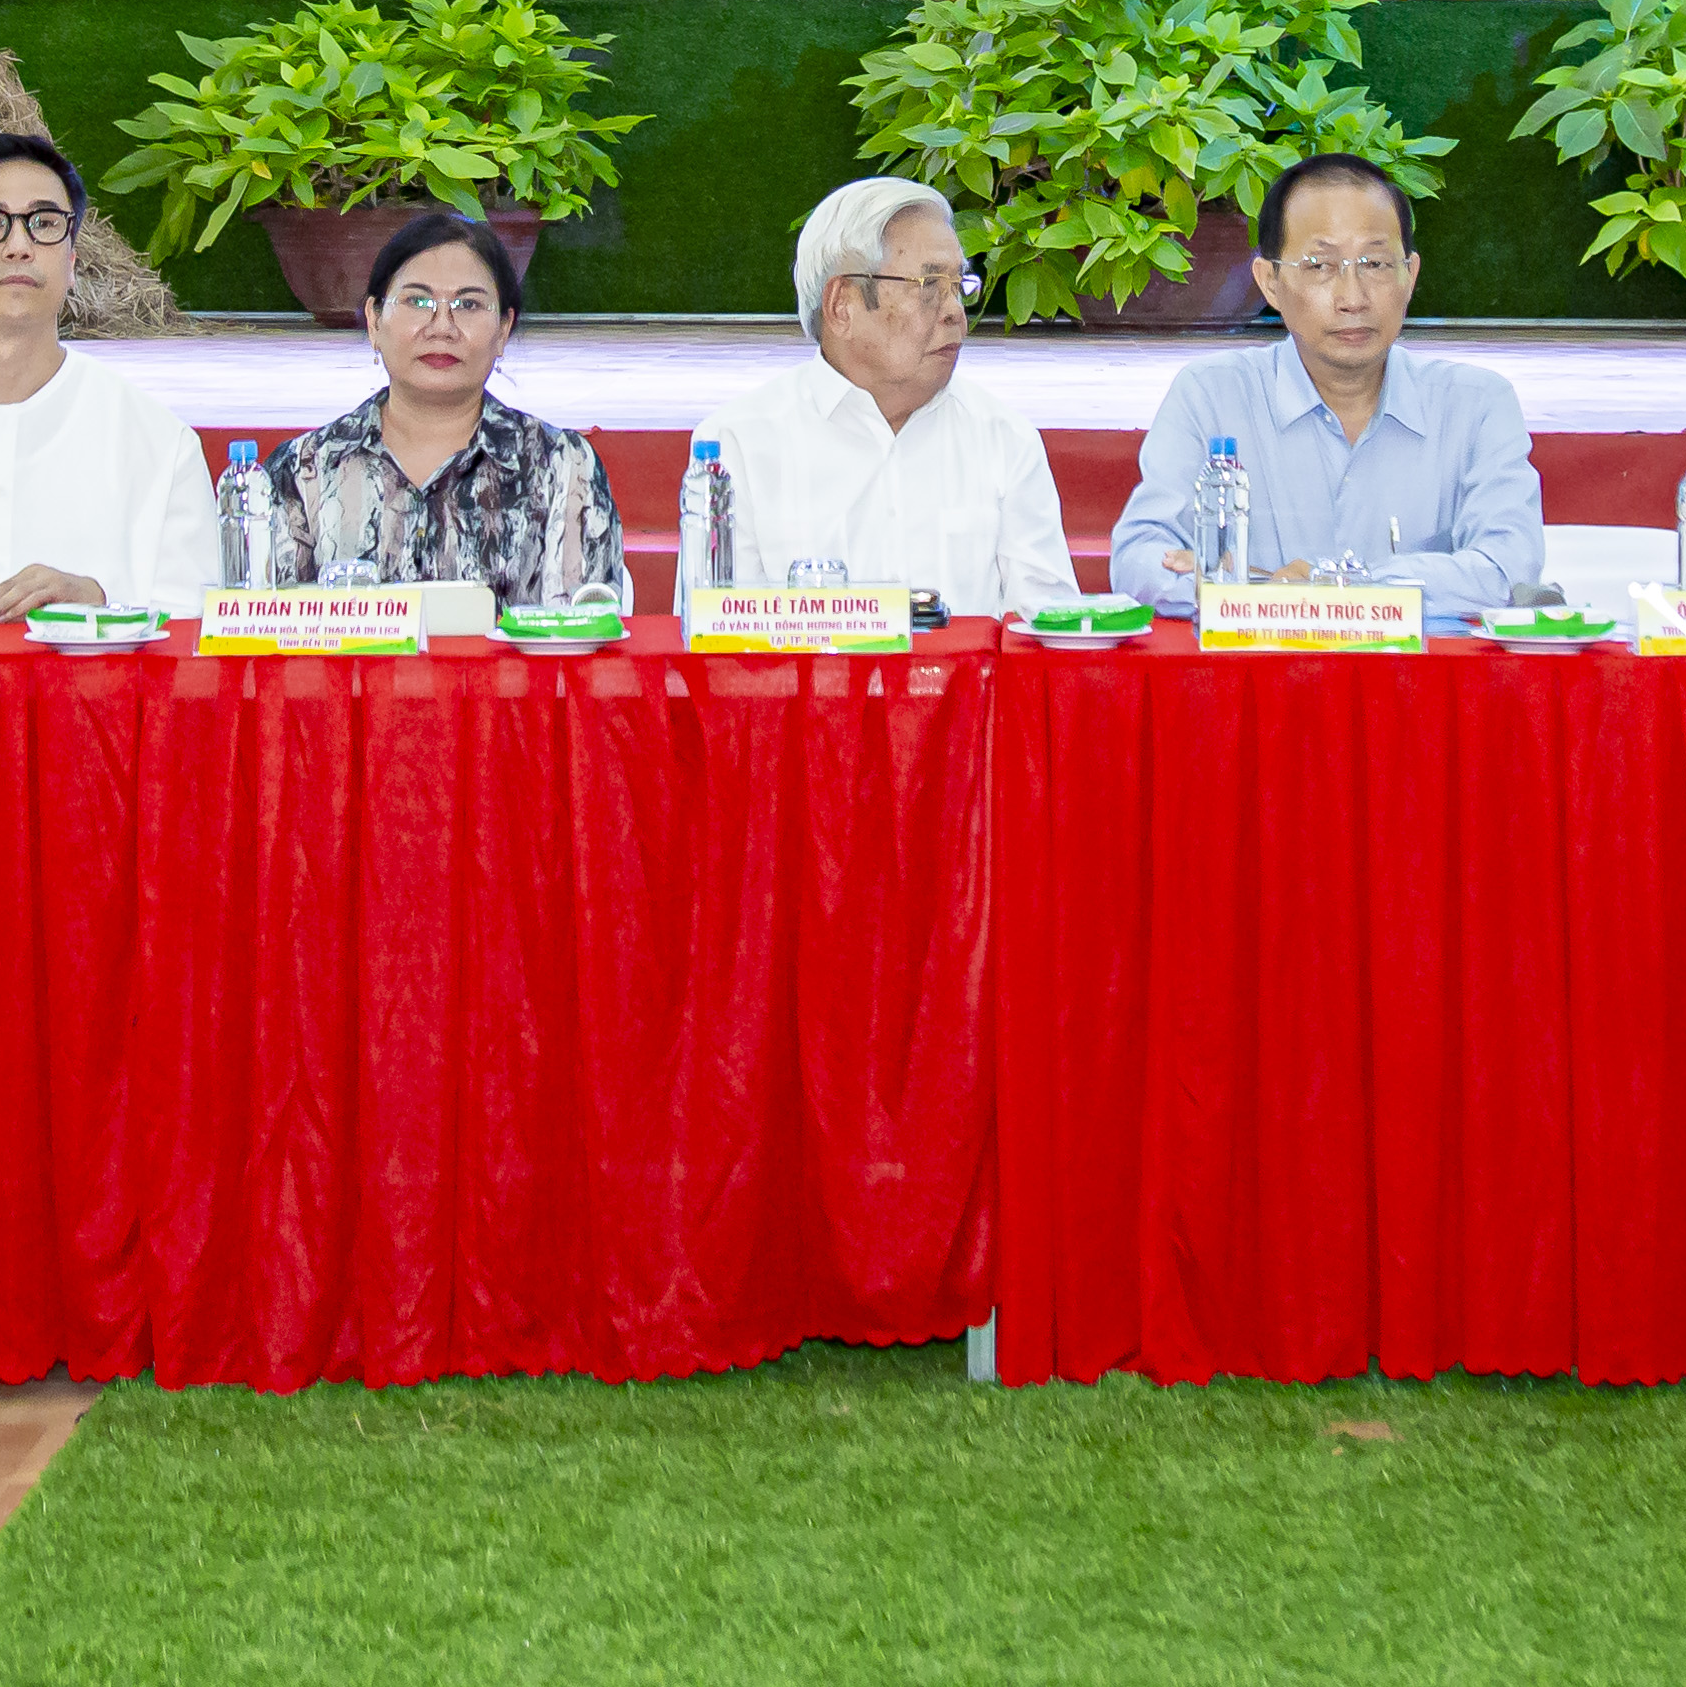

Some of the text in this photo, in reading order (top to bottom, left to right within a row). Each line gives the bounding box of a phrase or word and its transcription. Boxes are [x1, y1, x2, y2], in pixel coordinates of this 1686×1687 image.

[298, 600, 324, 621] THỊ
[722, 596, 757, 615] ÔNG
[763, 595, 782, 615] LÊ
[790, 595, 825, 615] TÂM
[1220, 598, 1252, 619] ÔNG
[1257, 597, 1320, 620] NGUYỄN
[1371, 604, 1403, 622] SƠN
